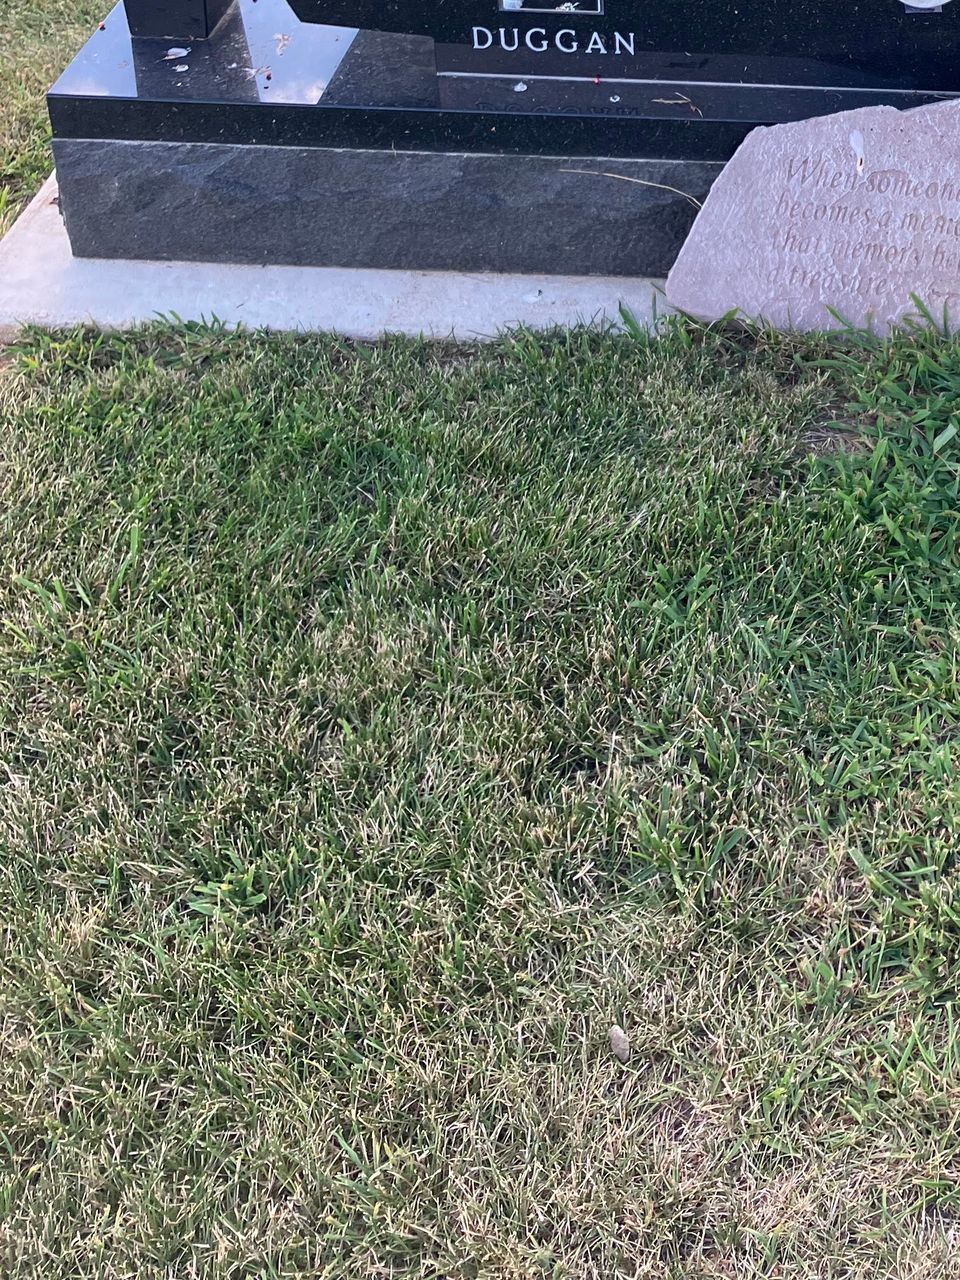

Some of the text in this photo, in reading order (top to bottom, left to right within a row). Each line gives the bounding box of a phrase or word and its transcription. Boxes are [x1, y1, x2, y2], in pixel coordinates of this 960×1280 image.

[472, 26, 635, 56] DUGGAN
[785, 155, 858, 192] When
[774, 190, 873, 227] becomes
[877, 208, 894, 230] a
[771, 227, 825, 255] that
[831, 238, 925, 268] memory
